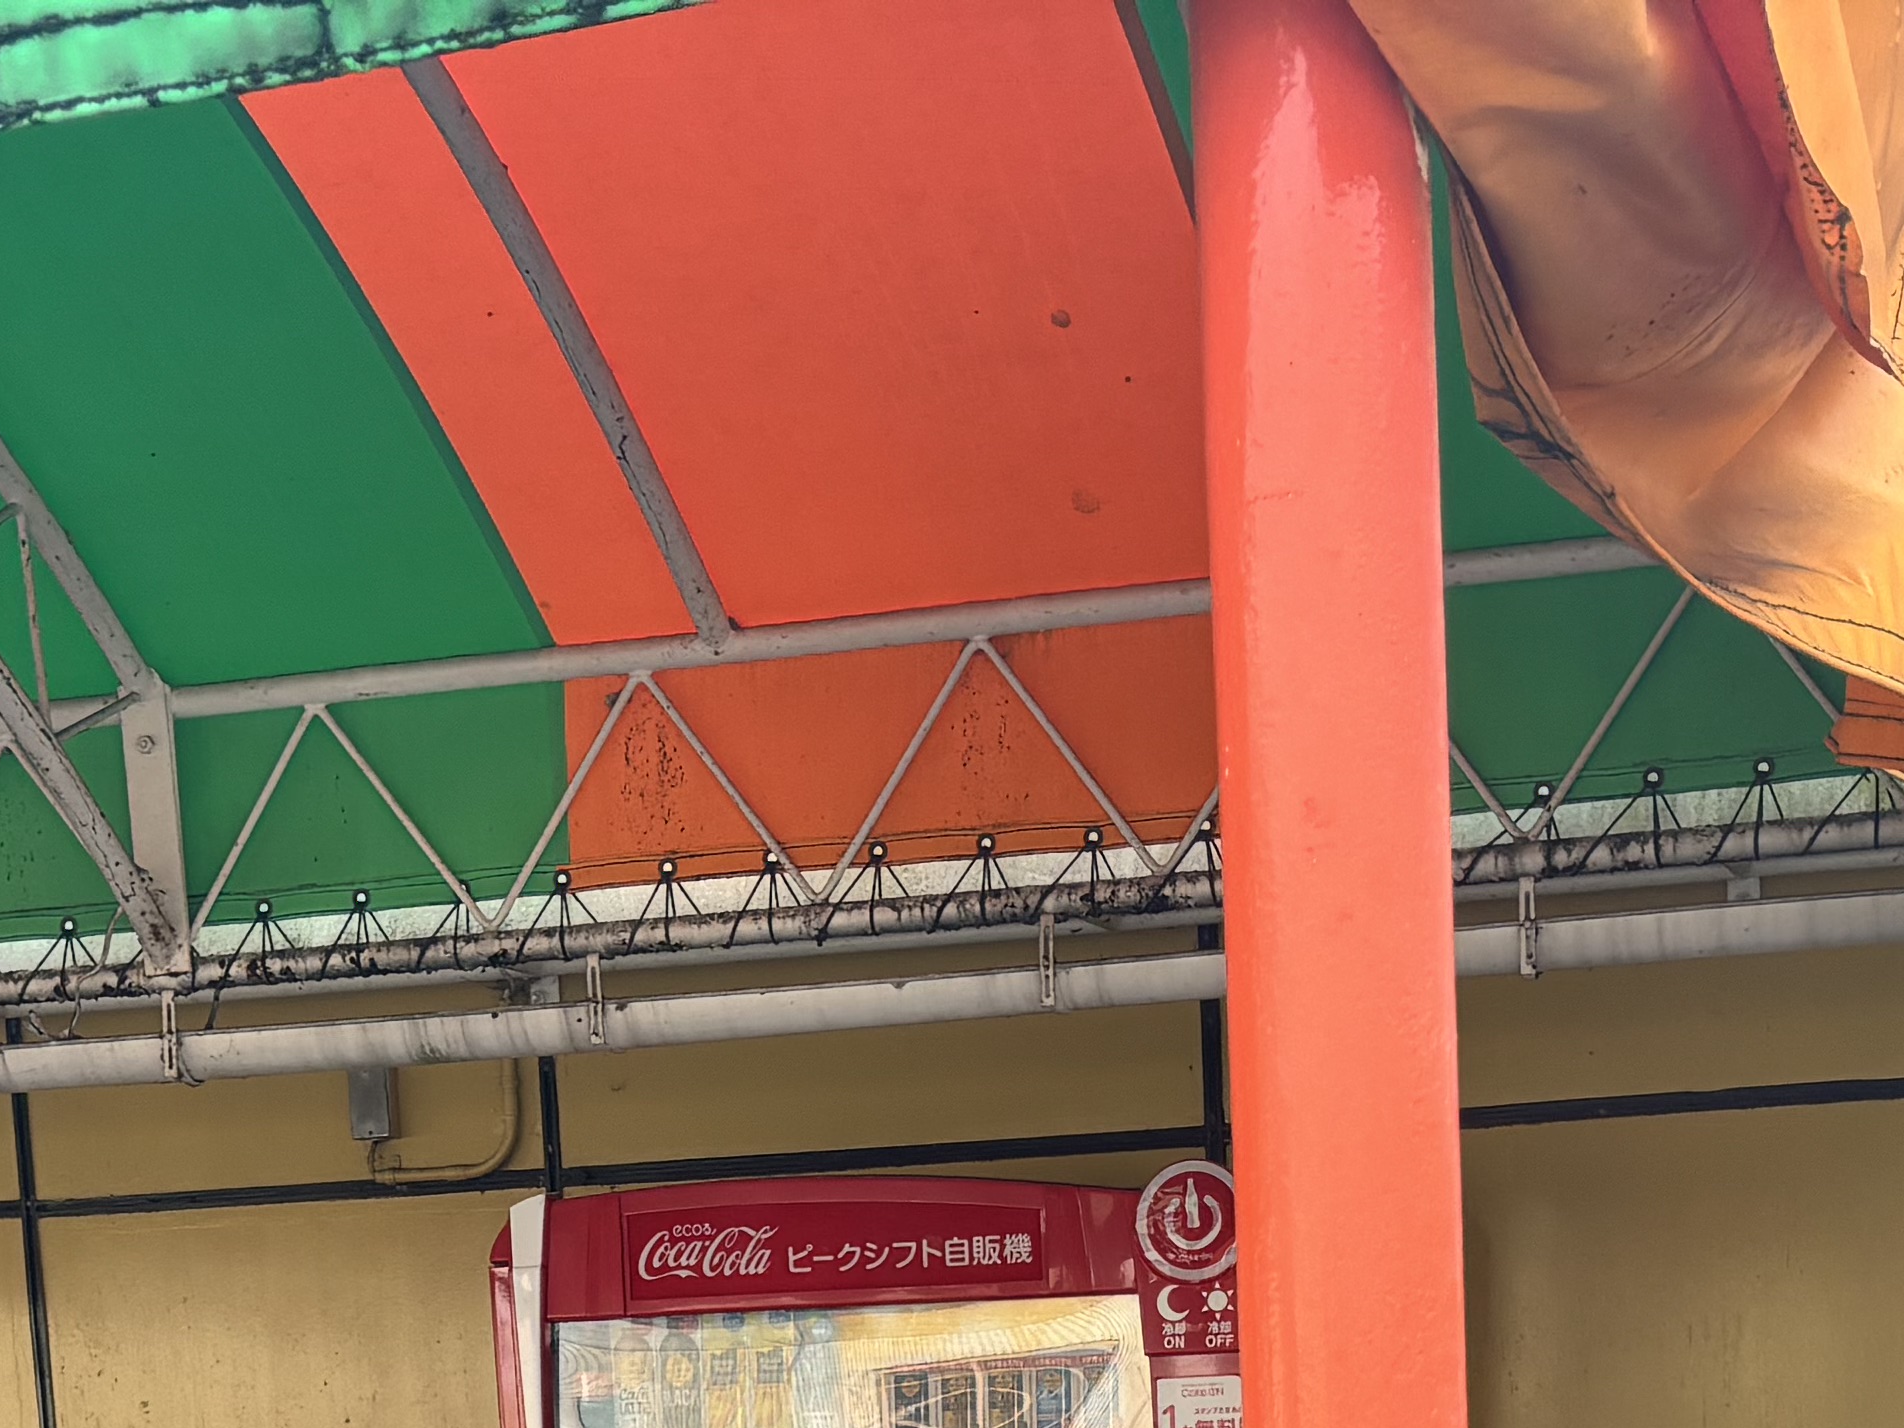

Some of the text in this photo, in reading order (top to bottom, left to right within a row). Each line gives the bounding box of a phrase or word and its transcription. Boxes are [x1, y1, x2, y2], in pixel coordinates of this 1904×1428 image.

[638, 1226, 1033, 1281] Coca-Cola ピークシフト自販機
[1163, 1334, 1235, 1349] ON OFF
